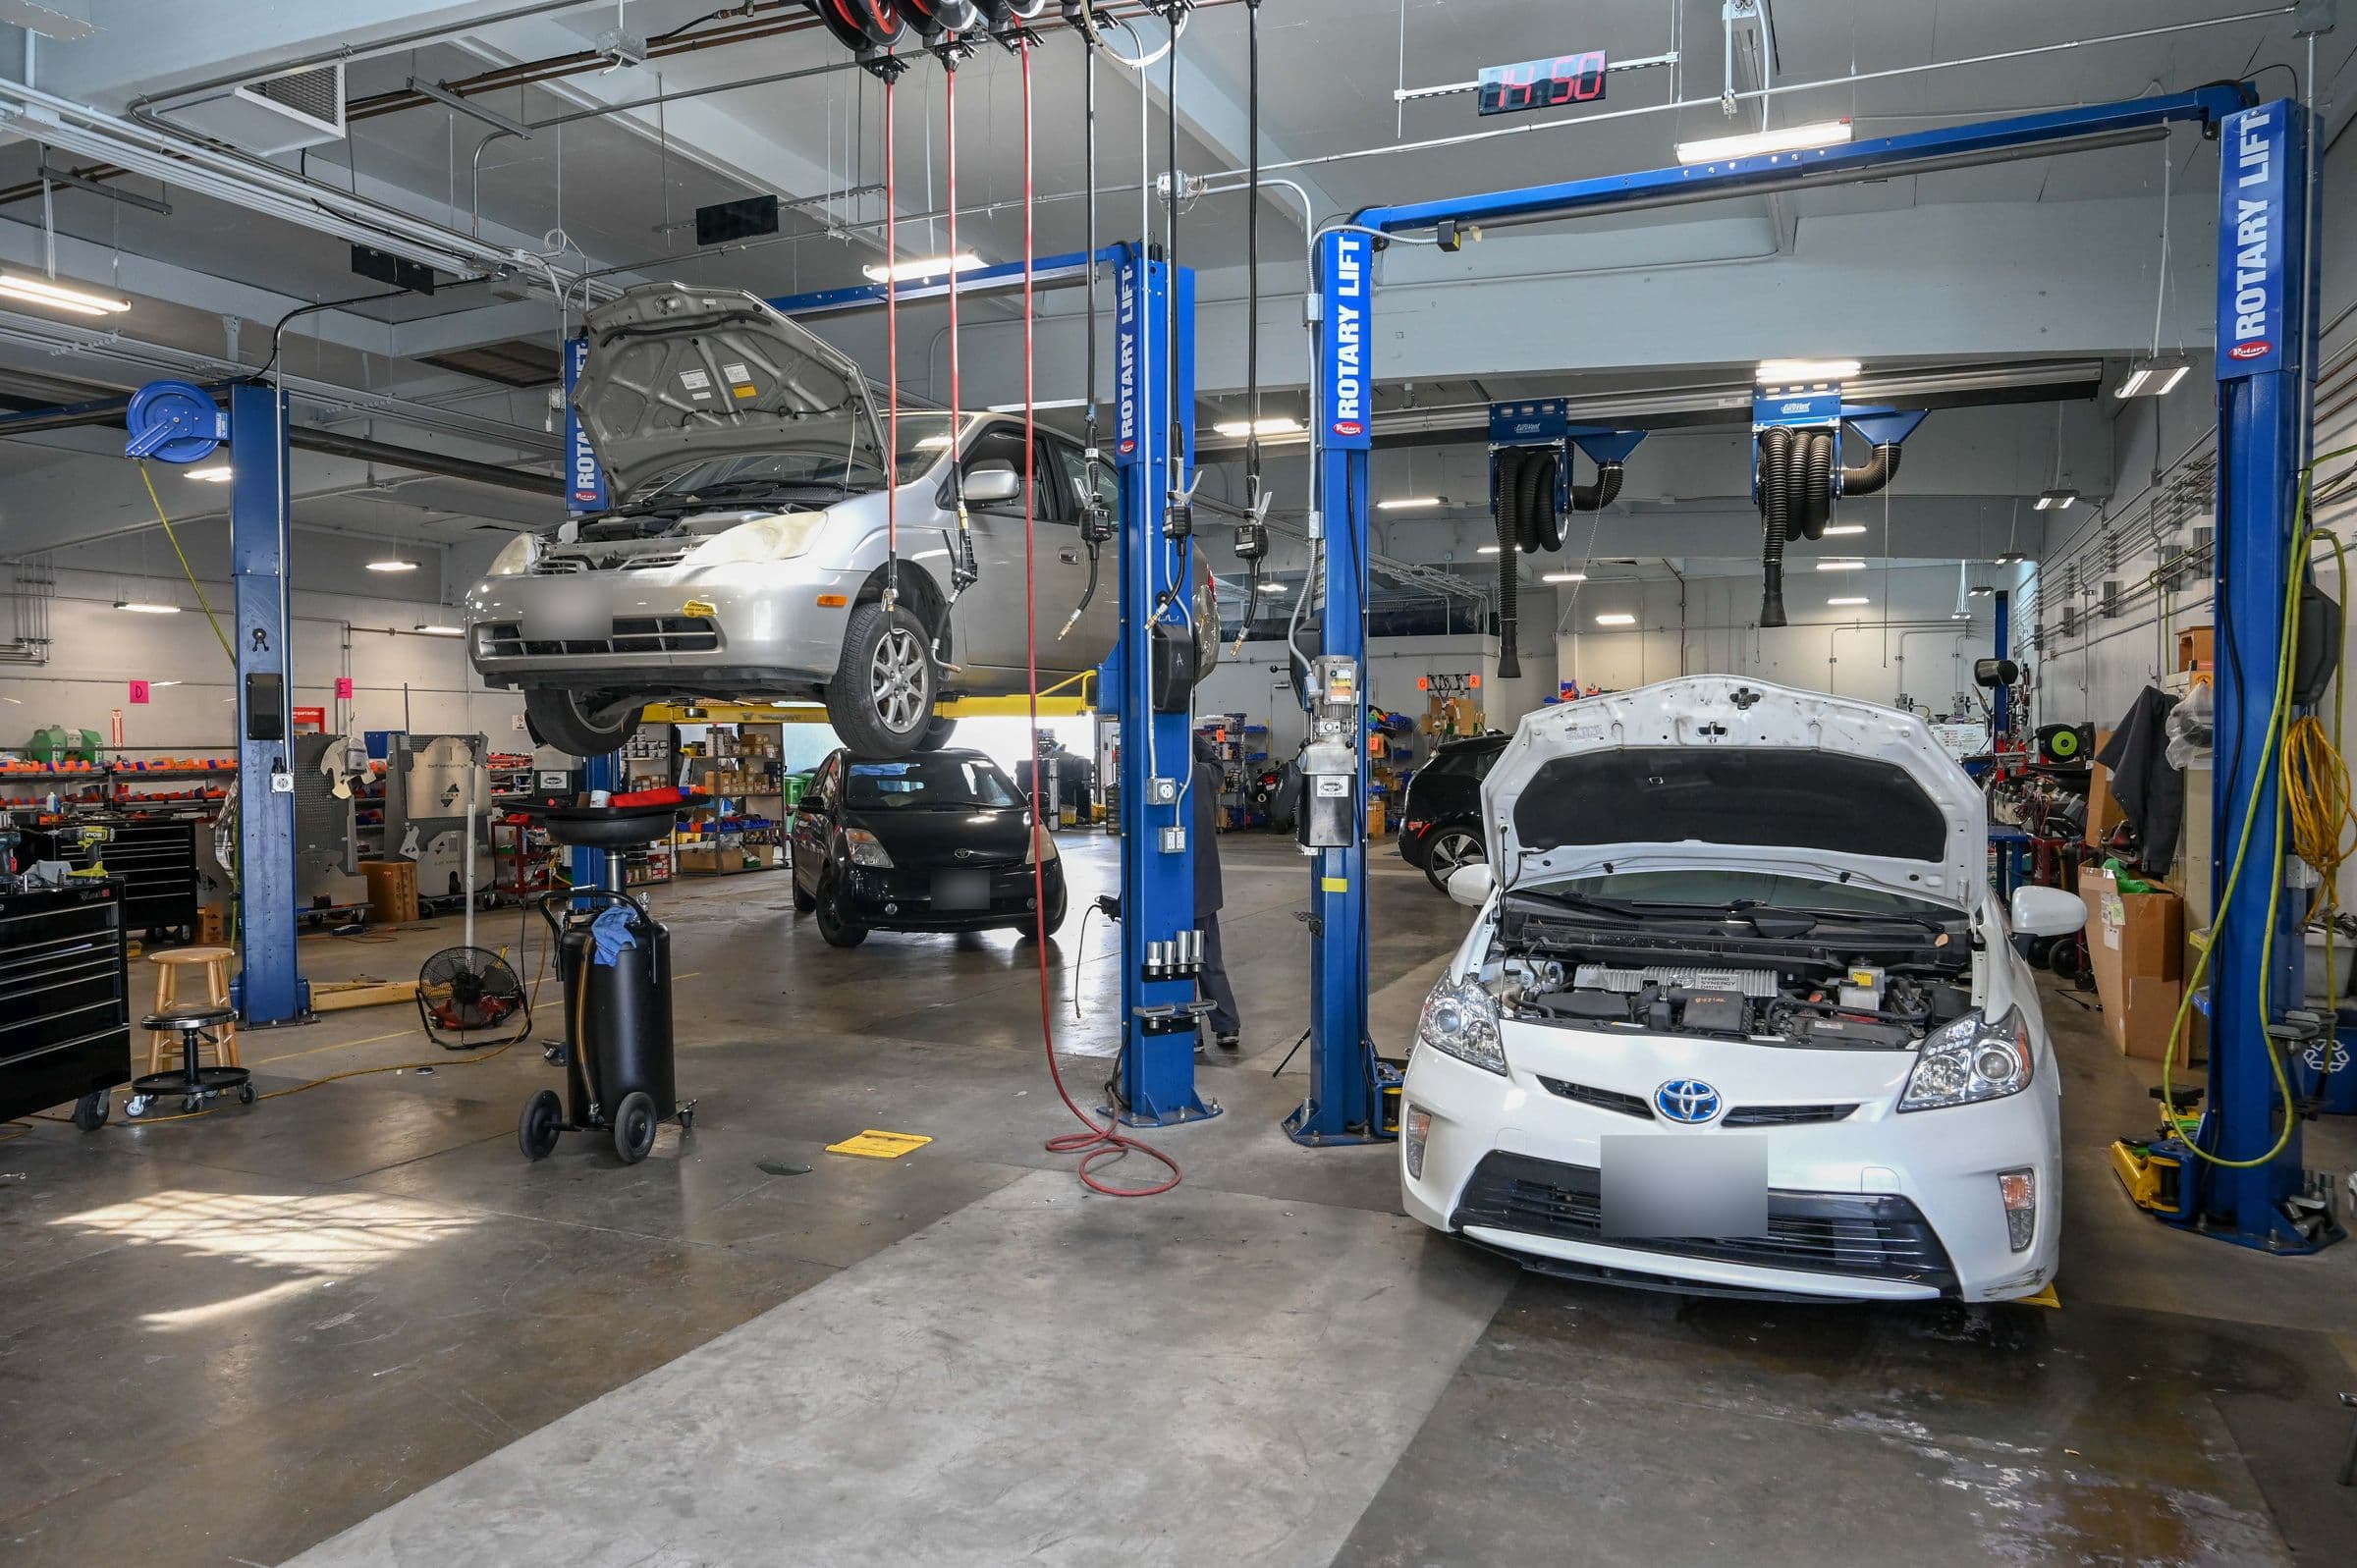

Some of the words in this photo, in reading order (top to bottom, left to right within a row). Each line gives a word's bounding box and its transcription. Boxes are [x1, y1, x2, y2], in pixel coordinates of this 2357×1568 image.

[2238, 112, 2271, 189] LIFT
[1338, 236, 1360, 297] LIFT
[2235, 199, 2268, 341] ROTARY
[1122, 268, 1133, 325] LIFT
[1337, 303, 1359, 419] ROTARY
[2231, 345, 2269, 357] Rotary
[1121, 333, 1133, 439] ROTARY
[1334, 422, 1361, 434] Rotary
[1177, 652, 1184, 667] A
[135, 684, 142, 699] D
